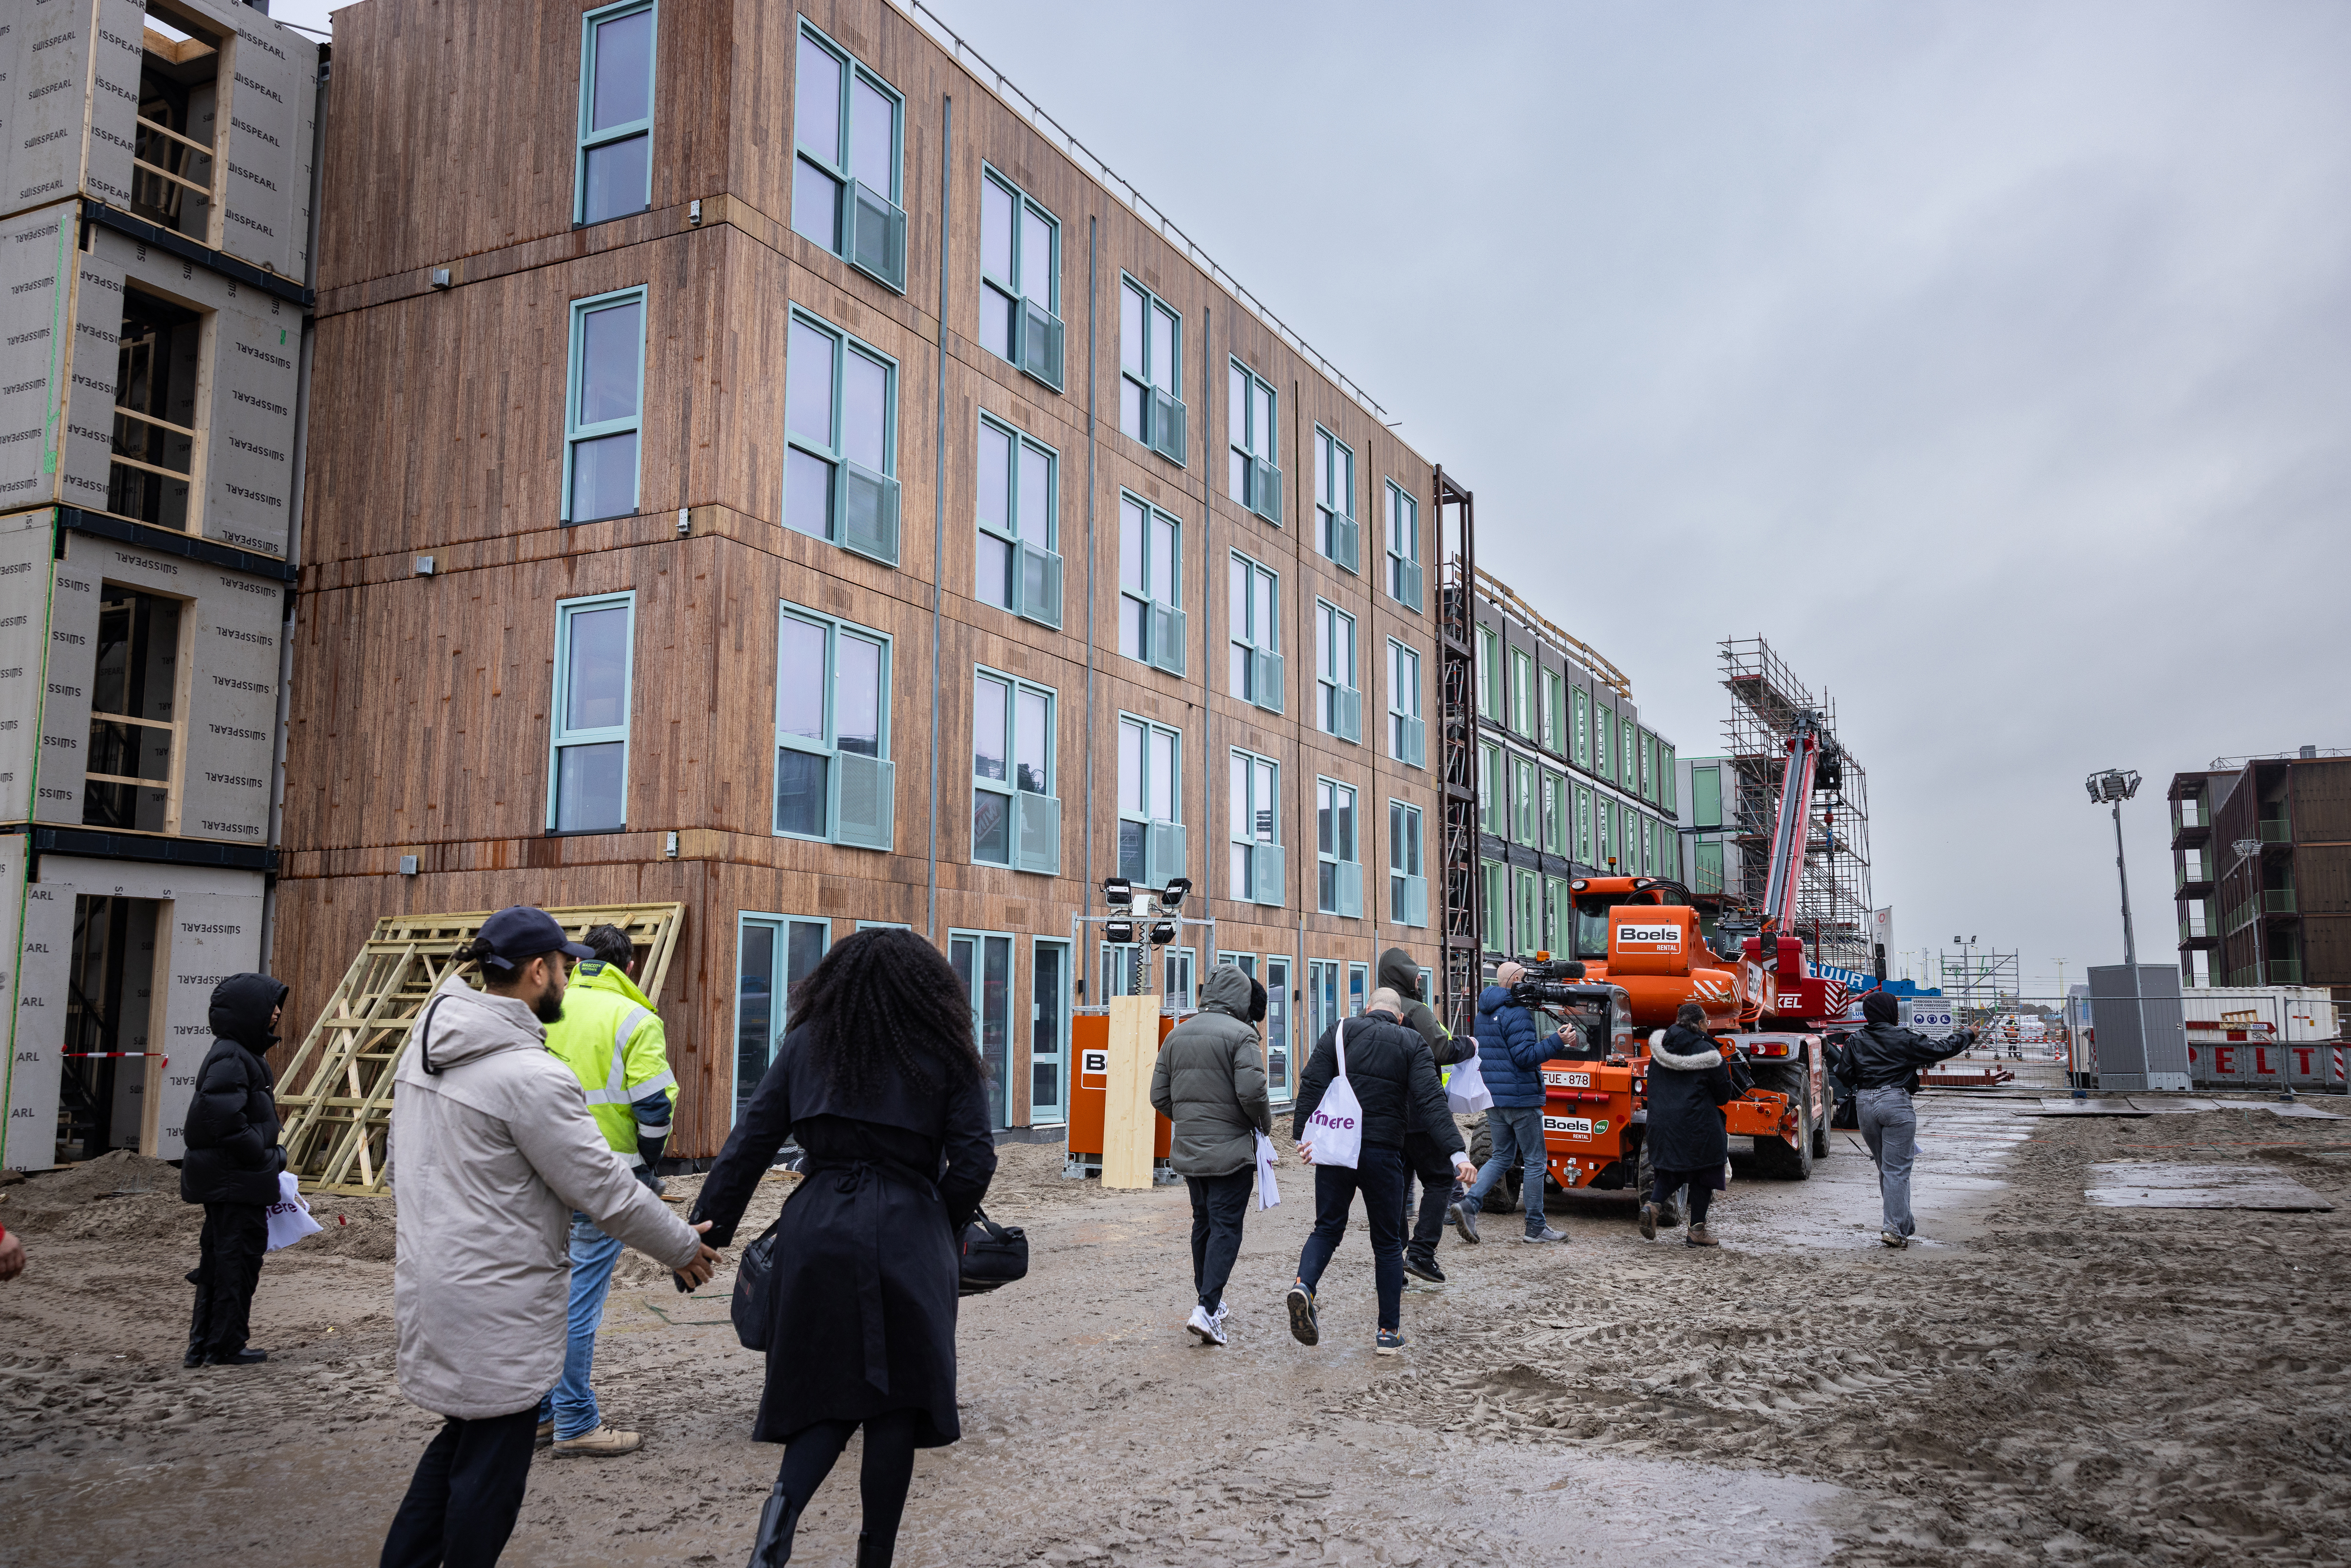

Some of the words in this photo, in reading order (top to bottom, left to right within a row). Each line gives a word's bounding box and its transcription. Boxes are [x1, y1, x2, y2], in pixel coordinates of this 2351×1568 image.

[33, 31, 76, 52] SWISSPEARL
[29, 79, 72, 99] SWISSPEARL
[24, 129, 68, 149] SWISSPEARL
[20, 179, 63, 199] SWISSPEARL
[16, 224, 58, 243] SWISSPEARL
[12, 276, 55, 295] SWISSPEARL
[7, 328, 50, 346] SWISSPEARL
[235, 342, 291, 369] SWISSPEARL
[3, 378, 46, 395] SWISSPEARL
[232, 390, 288, 416] SWISSPEARL
[229, 437, 285, 461] SWISSPEARL
[226, 484, 281, 507] SWISSPEARL
[222, 530, 278, 552] SWISSPEARL
[115, 552, 178, 575] SWISSPEARL
[220, 577, 276, 598] SWISSPEARL
[216, 626, 272, 646] SWISSPEARL
[213, 676, 269, 694] SWISSPEARL
[209, 724, 266, 741] SWISSPEARL
[205, 772, 263, 788] SWISSPEARL
[201, 820, 259, 835] SWISSPEARL
[29, 890, 54, 900] ARL
[181, 923, 241, 934] SWISSPEARL
[1620, 928, 1678, 941] Boels
[25, 943, 49, 953] ARL
[1807, 962, 1864, 987] HUUR
[20, 997, 44, 1007] ARL
[1087, 1054, 1107, 1071] B
[1544, 1119, 1589, 1131] Boels
